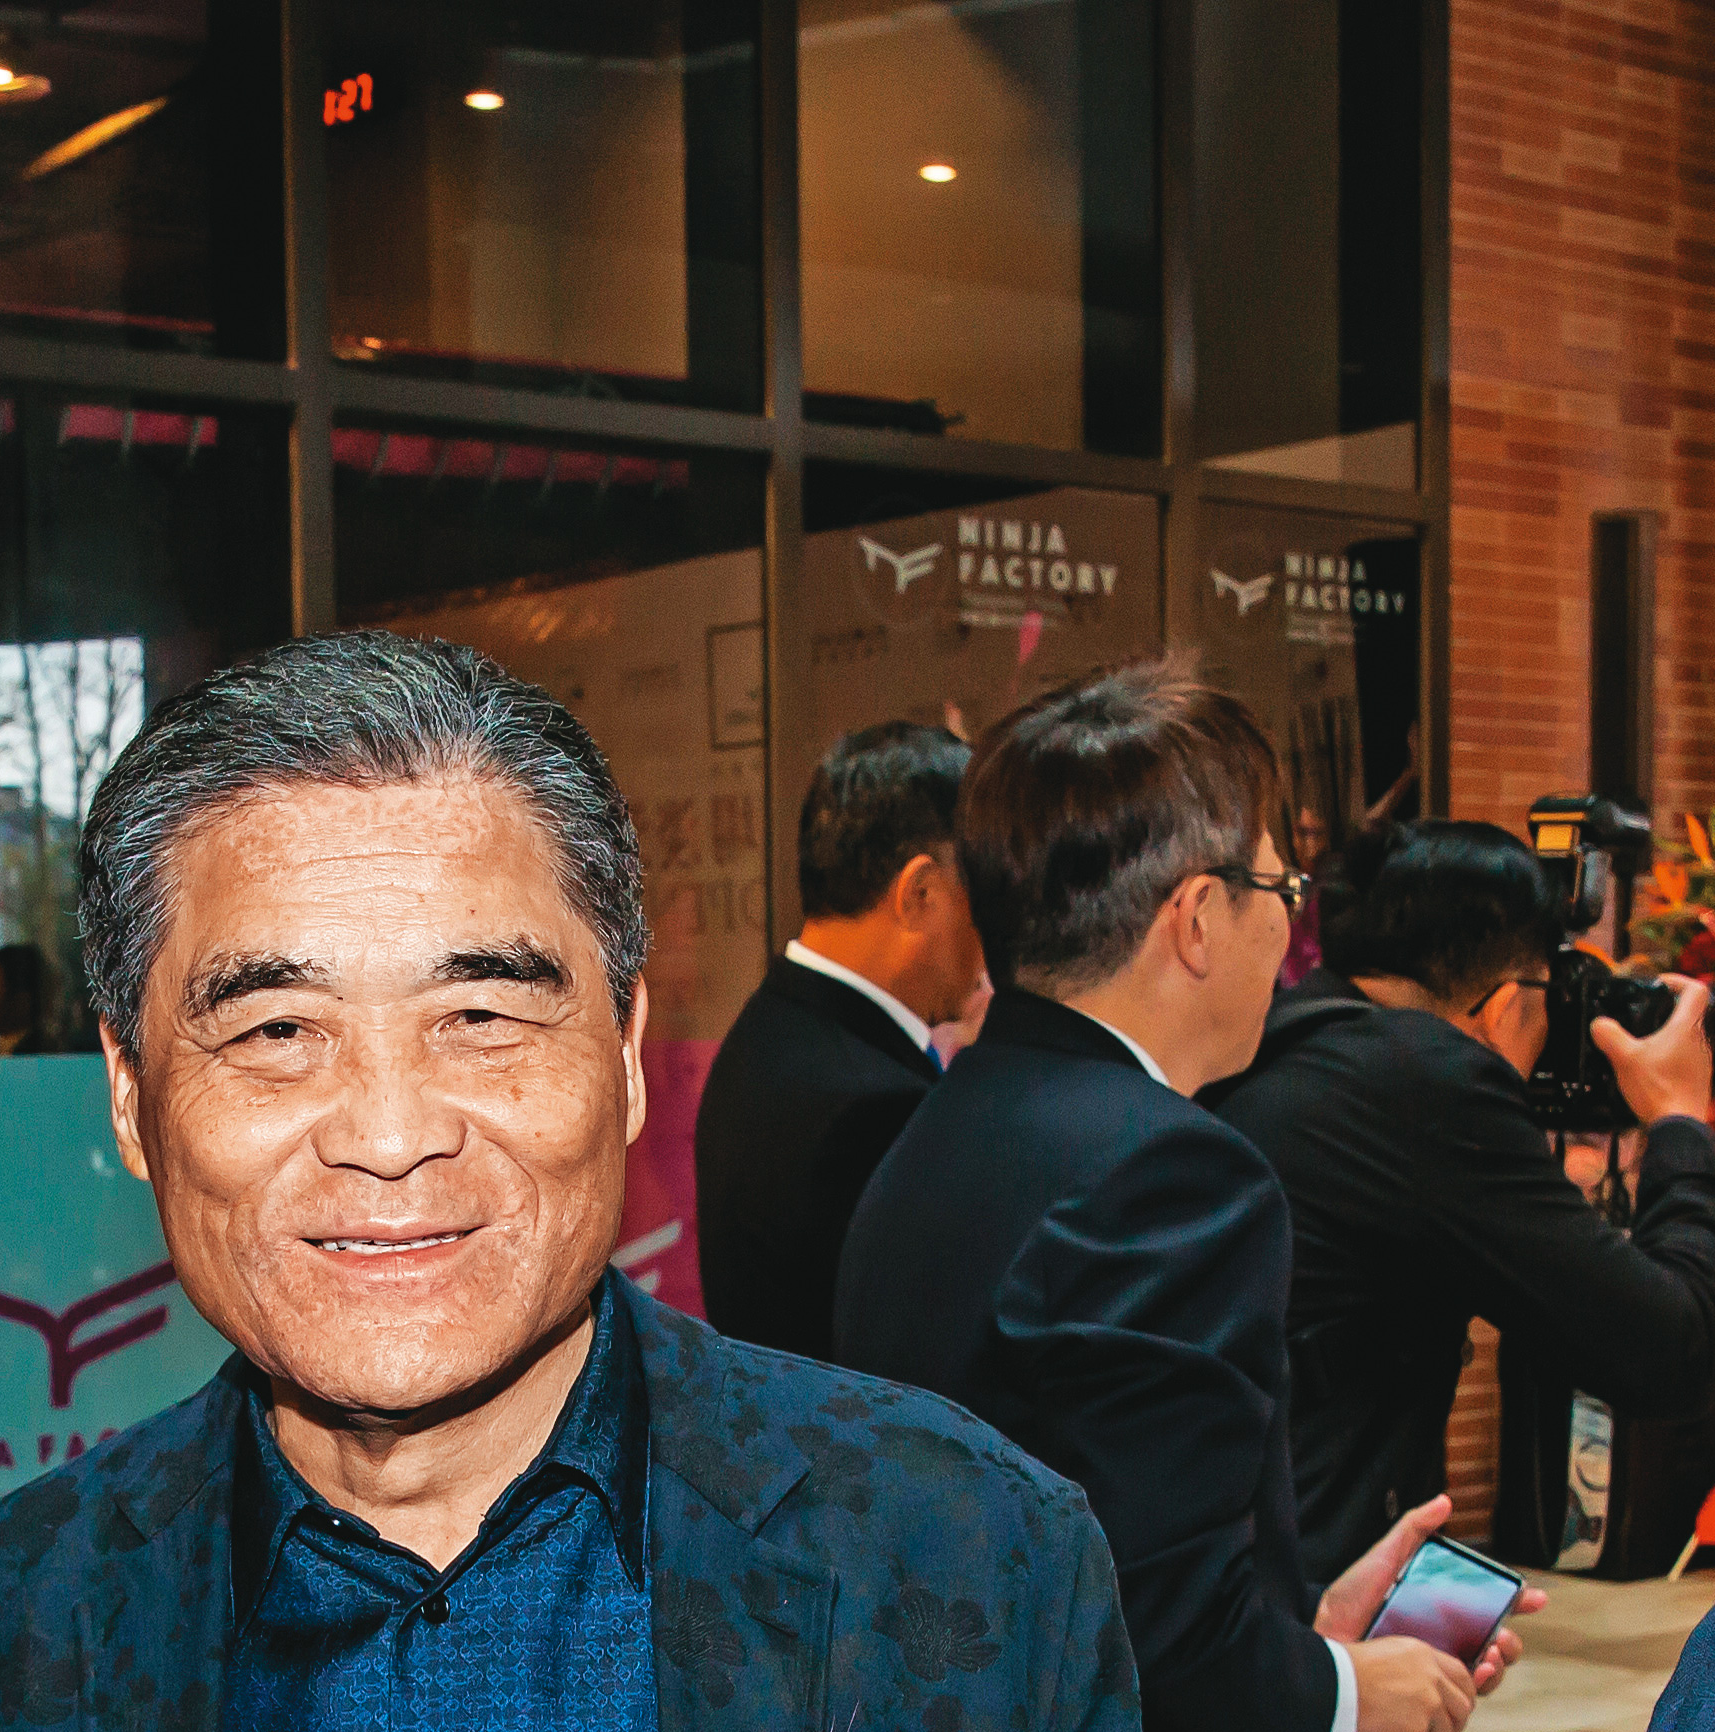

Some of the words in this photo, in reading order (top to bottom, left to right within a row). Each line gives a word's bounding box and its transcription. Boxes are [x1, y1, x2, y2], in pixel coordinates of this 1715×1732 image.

[957, 516, 1068, 553] NINJA
[958, 551, 1118, 597] FACTORY
[1285, 552, 1367, 583] NINJA
[1285, 582, 1406, 615] FACTORY
